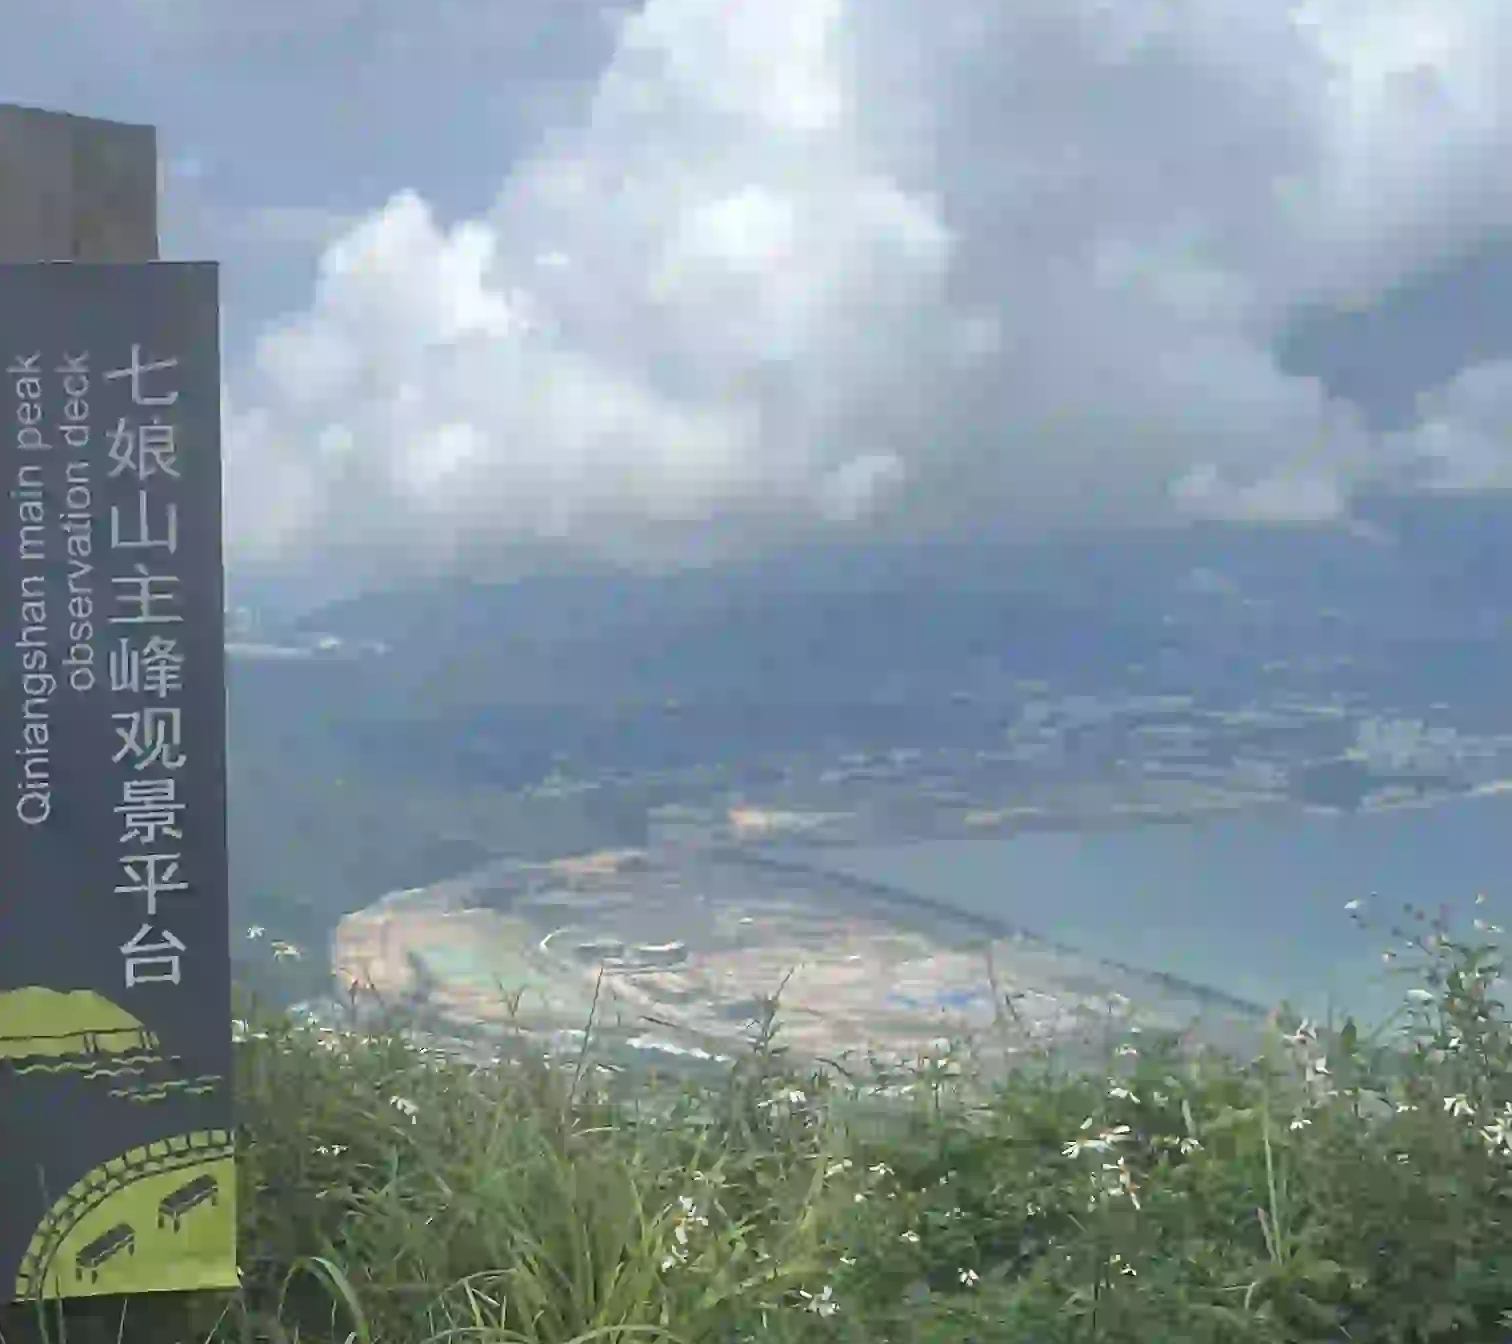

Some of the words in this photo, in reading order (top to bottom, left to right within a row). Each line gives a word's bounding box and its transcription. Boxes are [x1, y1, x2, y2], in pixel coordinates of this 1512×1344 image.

[6, 349, 53, 451] peak
[54, 349, 90, 448] deck
[9, 464, 46, 560] main
[59, 459, 96, 692] observation
[15, 575, 57, 825] Qiniangshan
[102, 342, 189, 989] 七娘山主峰观景平台
